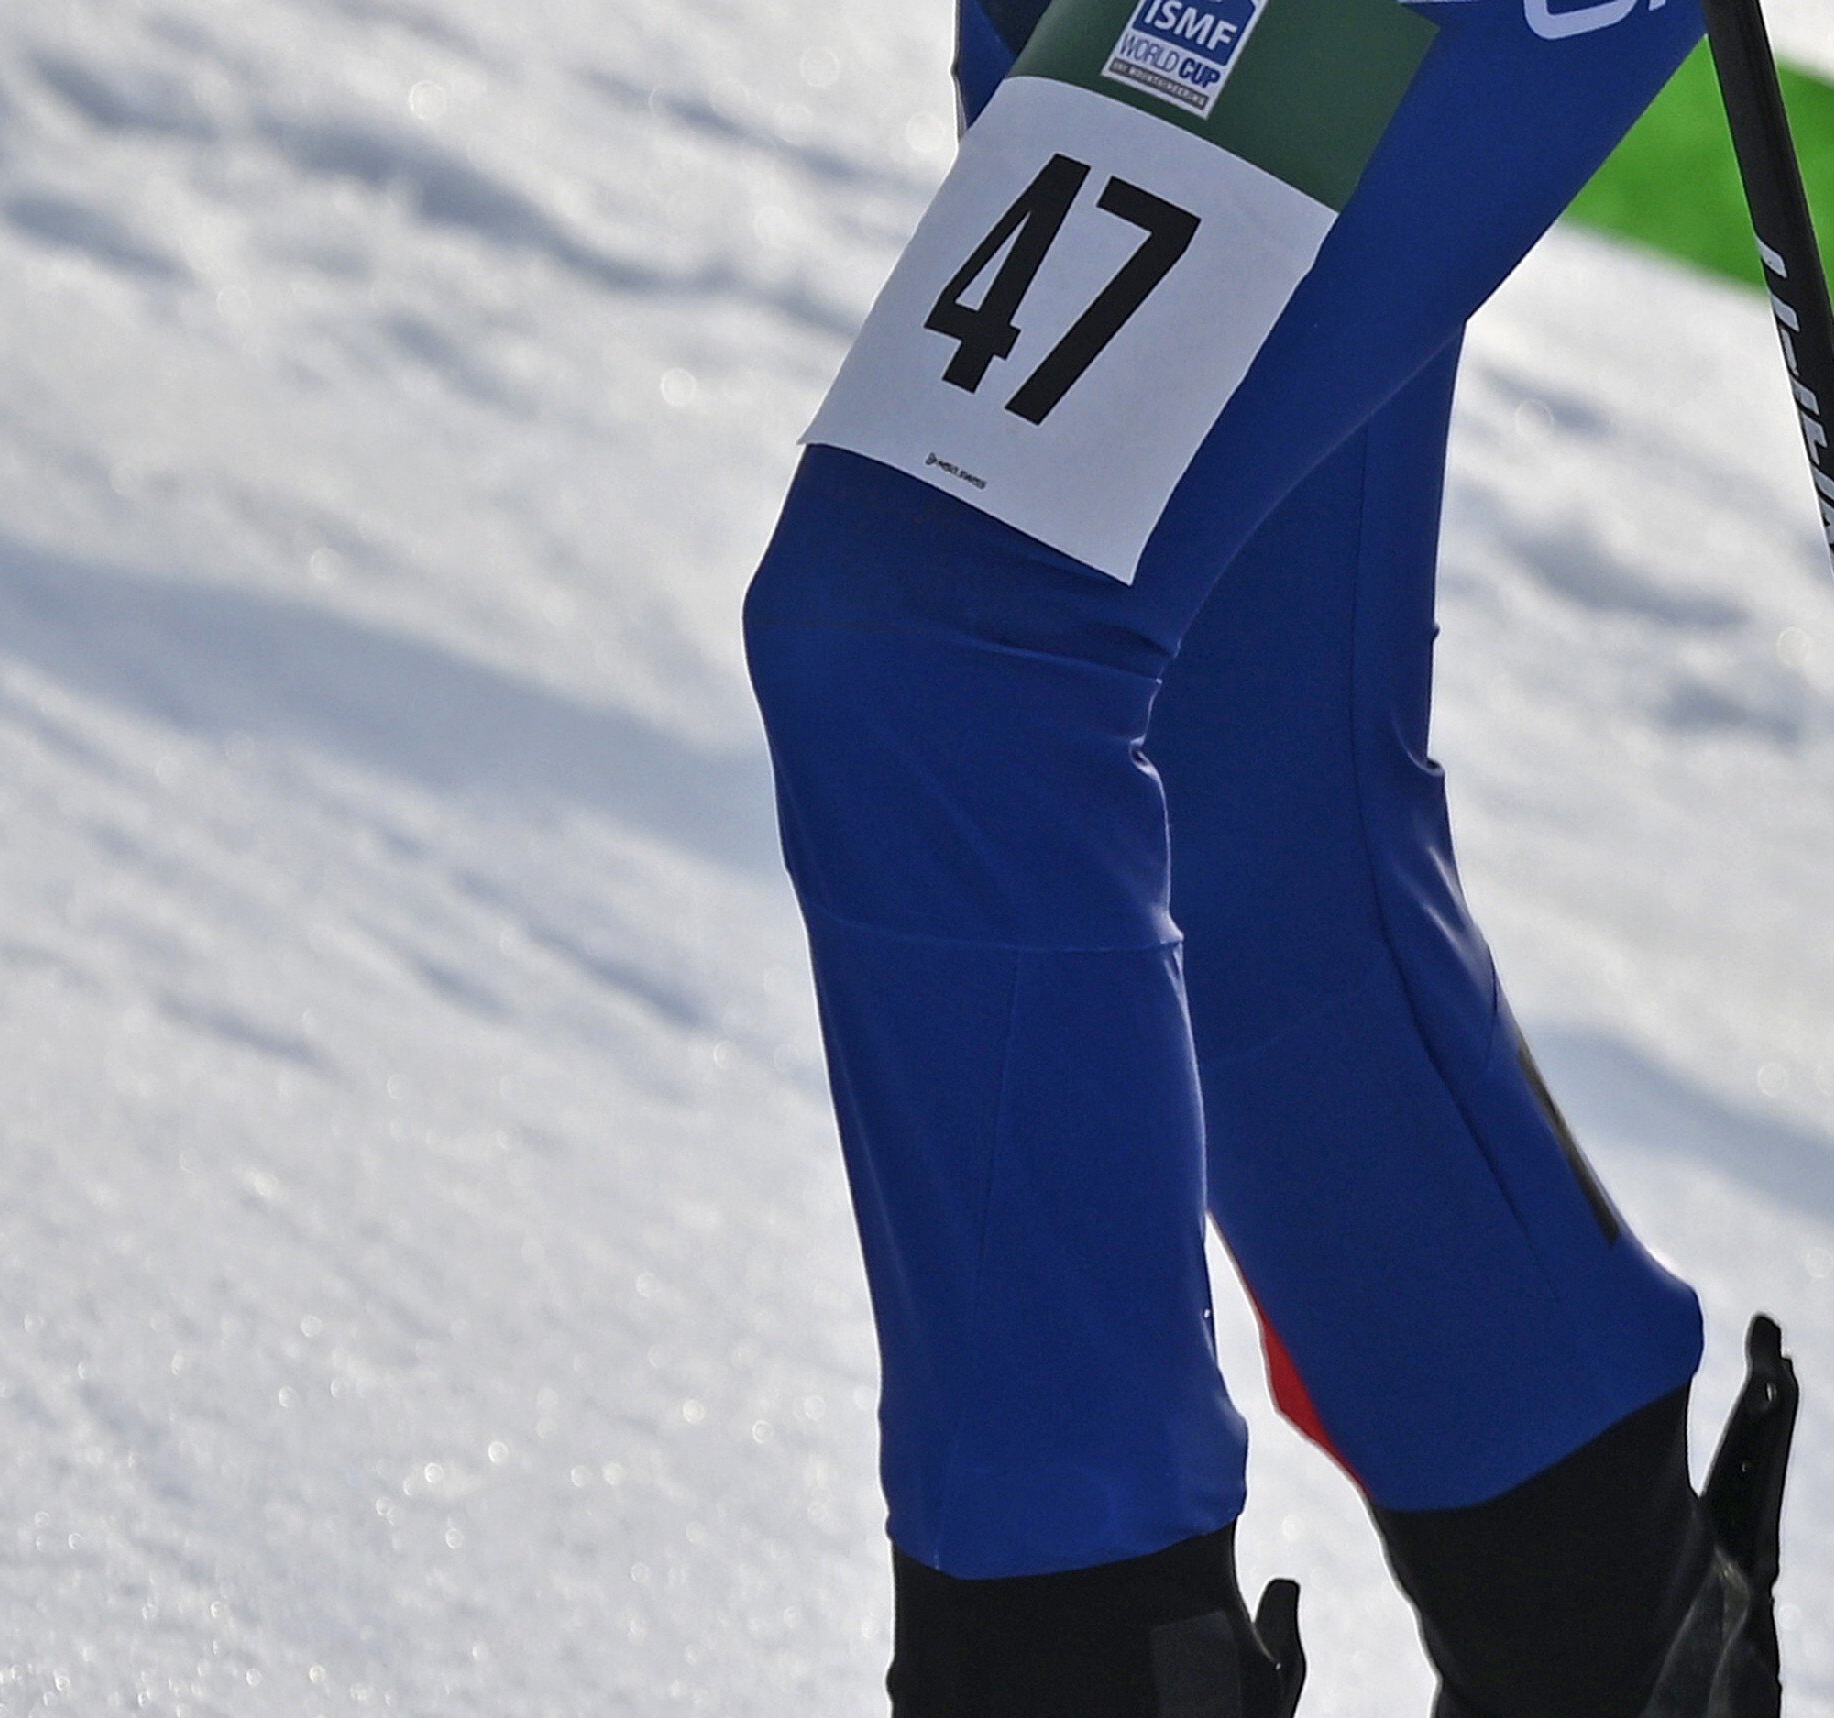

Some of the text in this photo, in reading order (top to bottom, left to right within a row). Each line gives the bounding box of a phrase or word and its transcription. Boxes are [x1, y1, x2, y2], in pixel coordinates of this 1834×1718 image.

[1144, 0, 1238, 50] ISMF
[1119, 34, 1179, 74] WORLD
[1178, 57, 1222, 89] CUP
[924, 153, 1201, 426] 47
